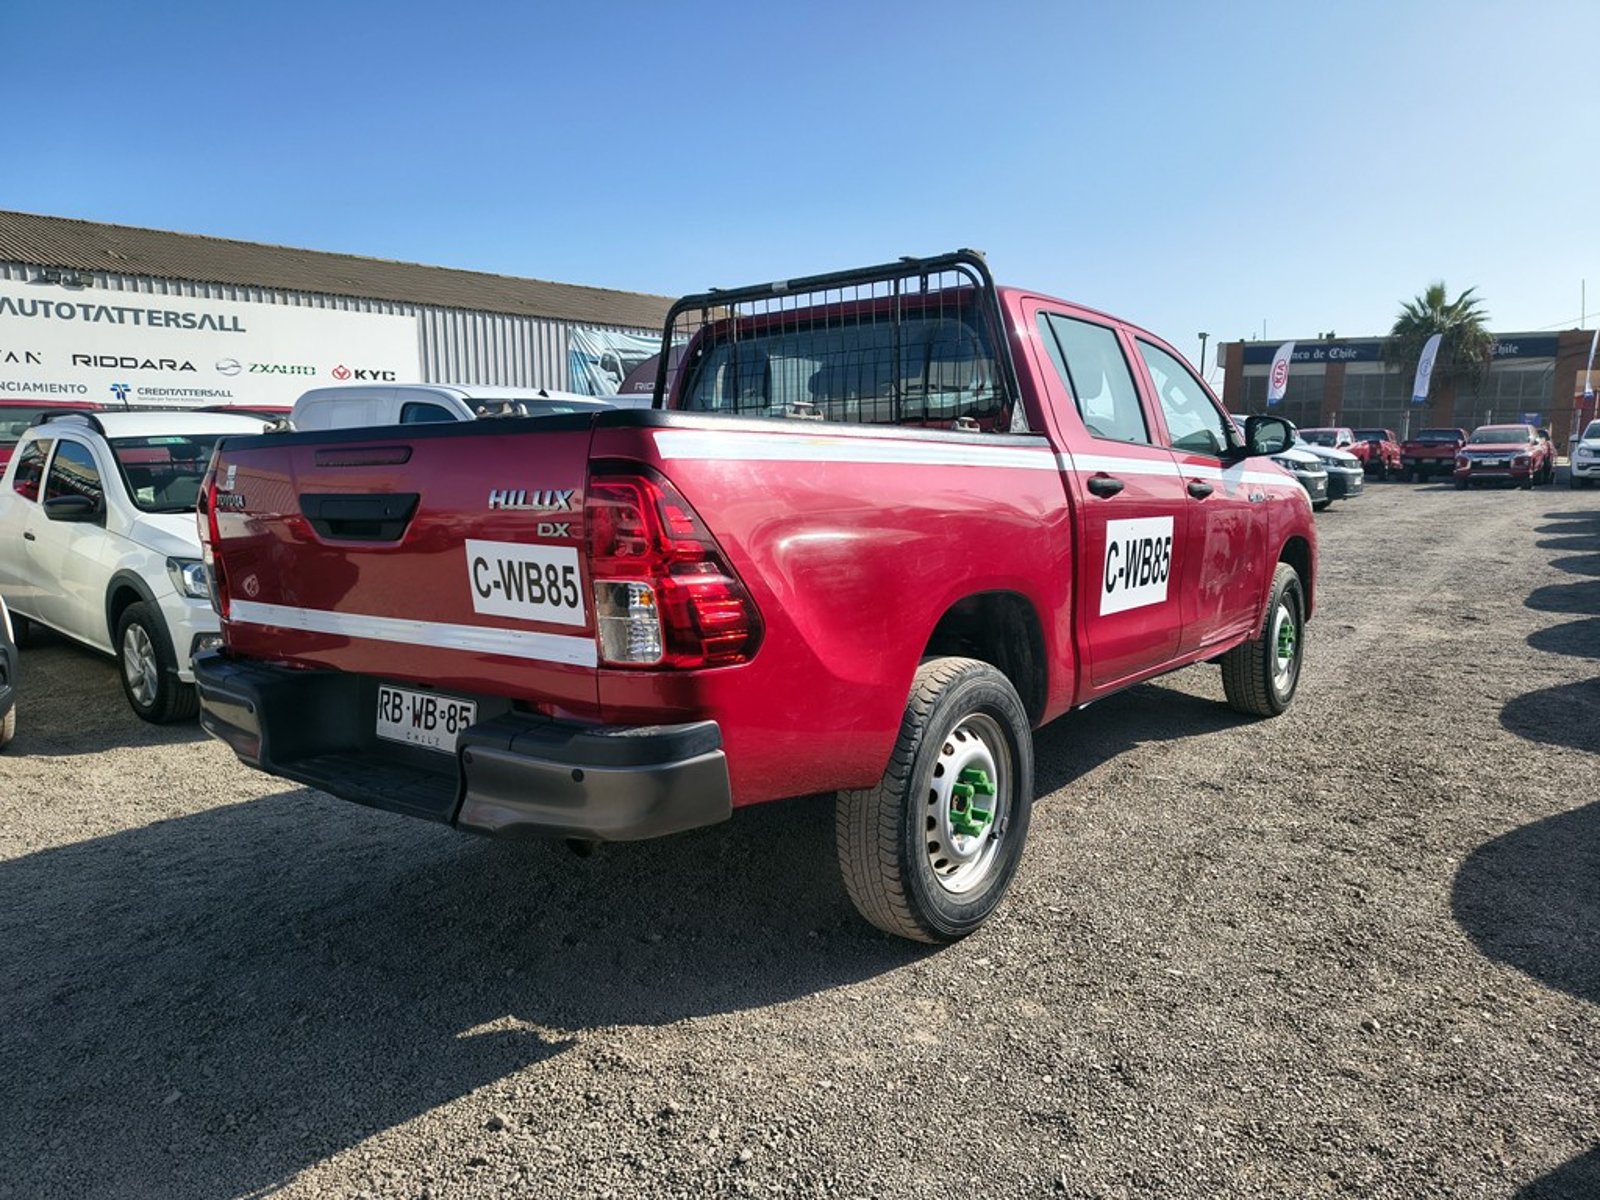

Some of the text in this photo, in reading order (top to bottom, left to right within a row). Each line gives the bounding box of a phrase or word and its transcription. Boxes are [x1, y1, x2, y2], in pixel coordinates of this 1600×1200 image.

[0, 296, 247, 333] AUTOTATTERSALL
[0, 349, 42, 365] AN
[1313, 348, 1325, 359] de
[1329, 347, 1358, 359] Chile
[72, 354, 197, 372] RIDDARA
[249, 363, 316, 376] ZXAUTO
[354, 369, 396, 382] KYC
[1274, 361, 1287, 384] KIA
[137, 386, 233, 398] CREDITATTERSALL
[489, 488, 574, 511] HILUX
[537, 522, 571, 537] DX
[1105, 536, 1171, 594] C-WB85
[473, 556, 579, 609] C-WB85
